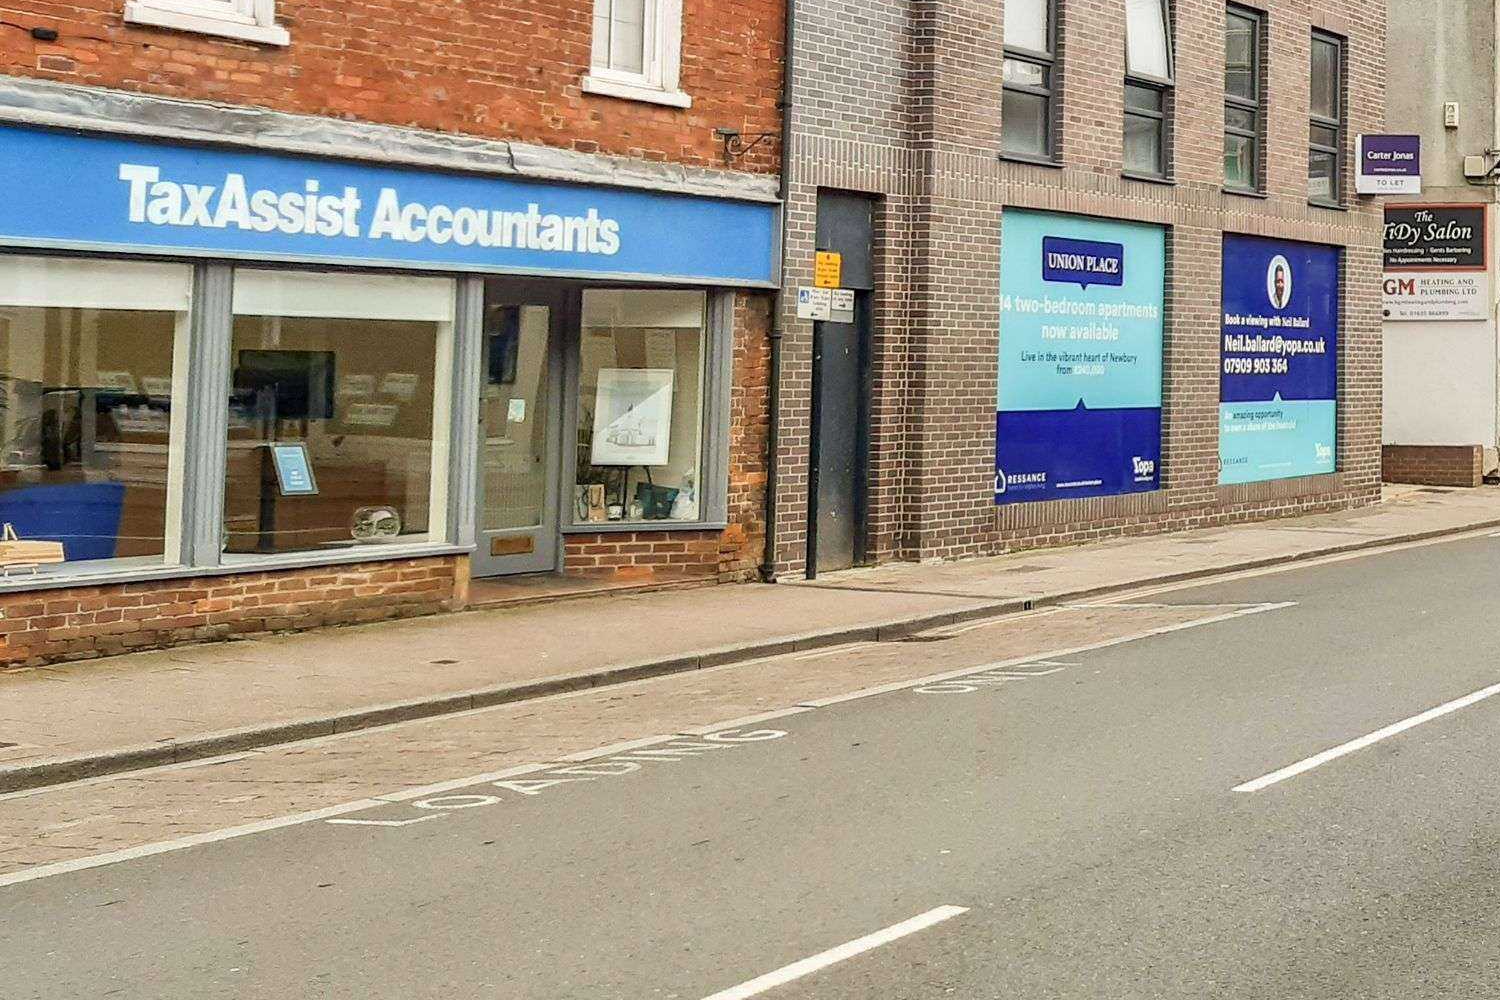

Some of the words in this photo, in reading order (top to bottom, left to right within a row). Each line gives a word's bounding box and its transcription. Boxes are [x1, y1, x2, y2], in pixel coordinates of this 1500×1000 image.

[1367, 151, 1391, 160] Carter
[1392, 151, 1414, 161] Jonas
[118, 163, 362, 239] TaxAssist
[369, 188, 620, 256] Accountants
[1414, 210, 1433, 222] The
[1383, 222, 1421, 246] TiDy
[1423, 221, 1472, 241] Salon
[1048, 253, 1084, 271] UNION
[1087, 256, 1118, 274] PLACE
[1015, 295, 1095, 316] two-bedroom
[1098, 302, 1158, 320] apartments
[1225, 314, 1240, 325] Book
[1241, 317, 1245, 325] a
[1246, 315, 1268, 328] viewing
[1269, 315, 1281, 326] with
[1041, 324, 1067, 339] now
[1069, 322, 1119, 341] available
[1224, 334, 1325, 356] Neil.ballard@yopa.co.uk
[1021, 351, 1036, 362] Live
[1038, 352, 1044, 361] in
[1046, 352, 1057, 361] the
[1058, 352, 1082, 362] vibrant
[1083, 352, 1100, 363] heart
[1101, 353, 1108, 363] of
[1110, 353, 1137, 364] Newbury
[1224, 358, 1252, 374] 07909
[1253, 358, 1270, 374] 903
[1271, 358, 1288, 374] 364
[1056, 364, 1073, 375] from
[1007, 472, 1047, 484] RESSANCE
[325, 726, 788, 829] LOADING
[912, 659, 1083, 695] ONLY
